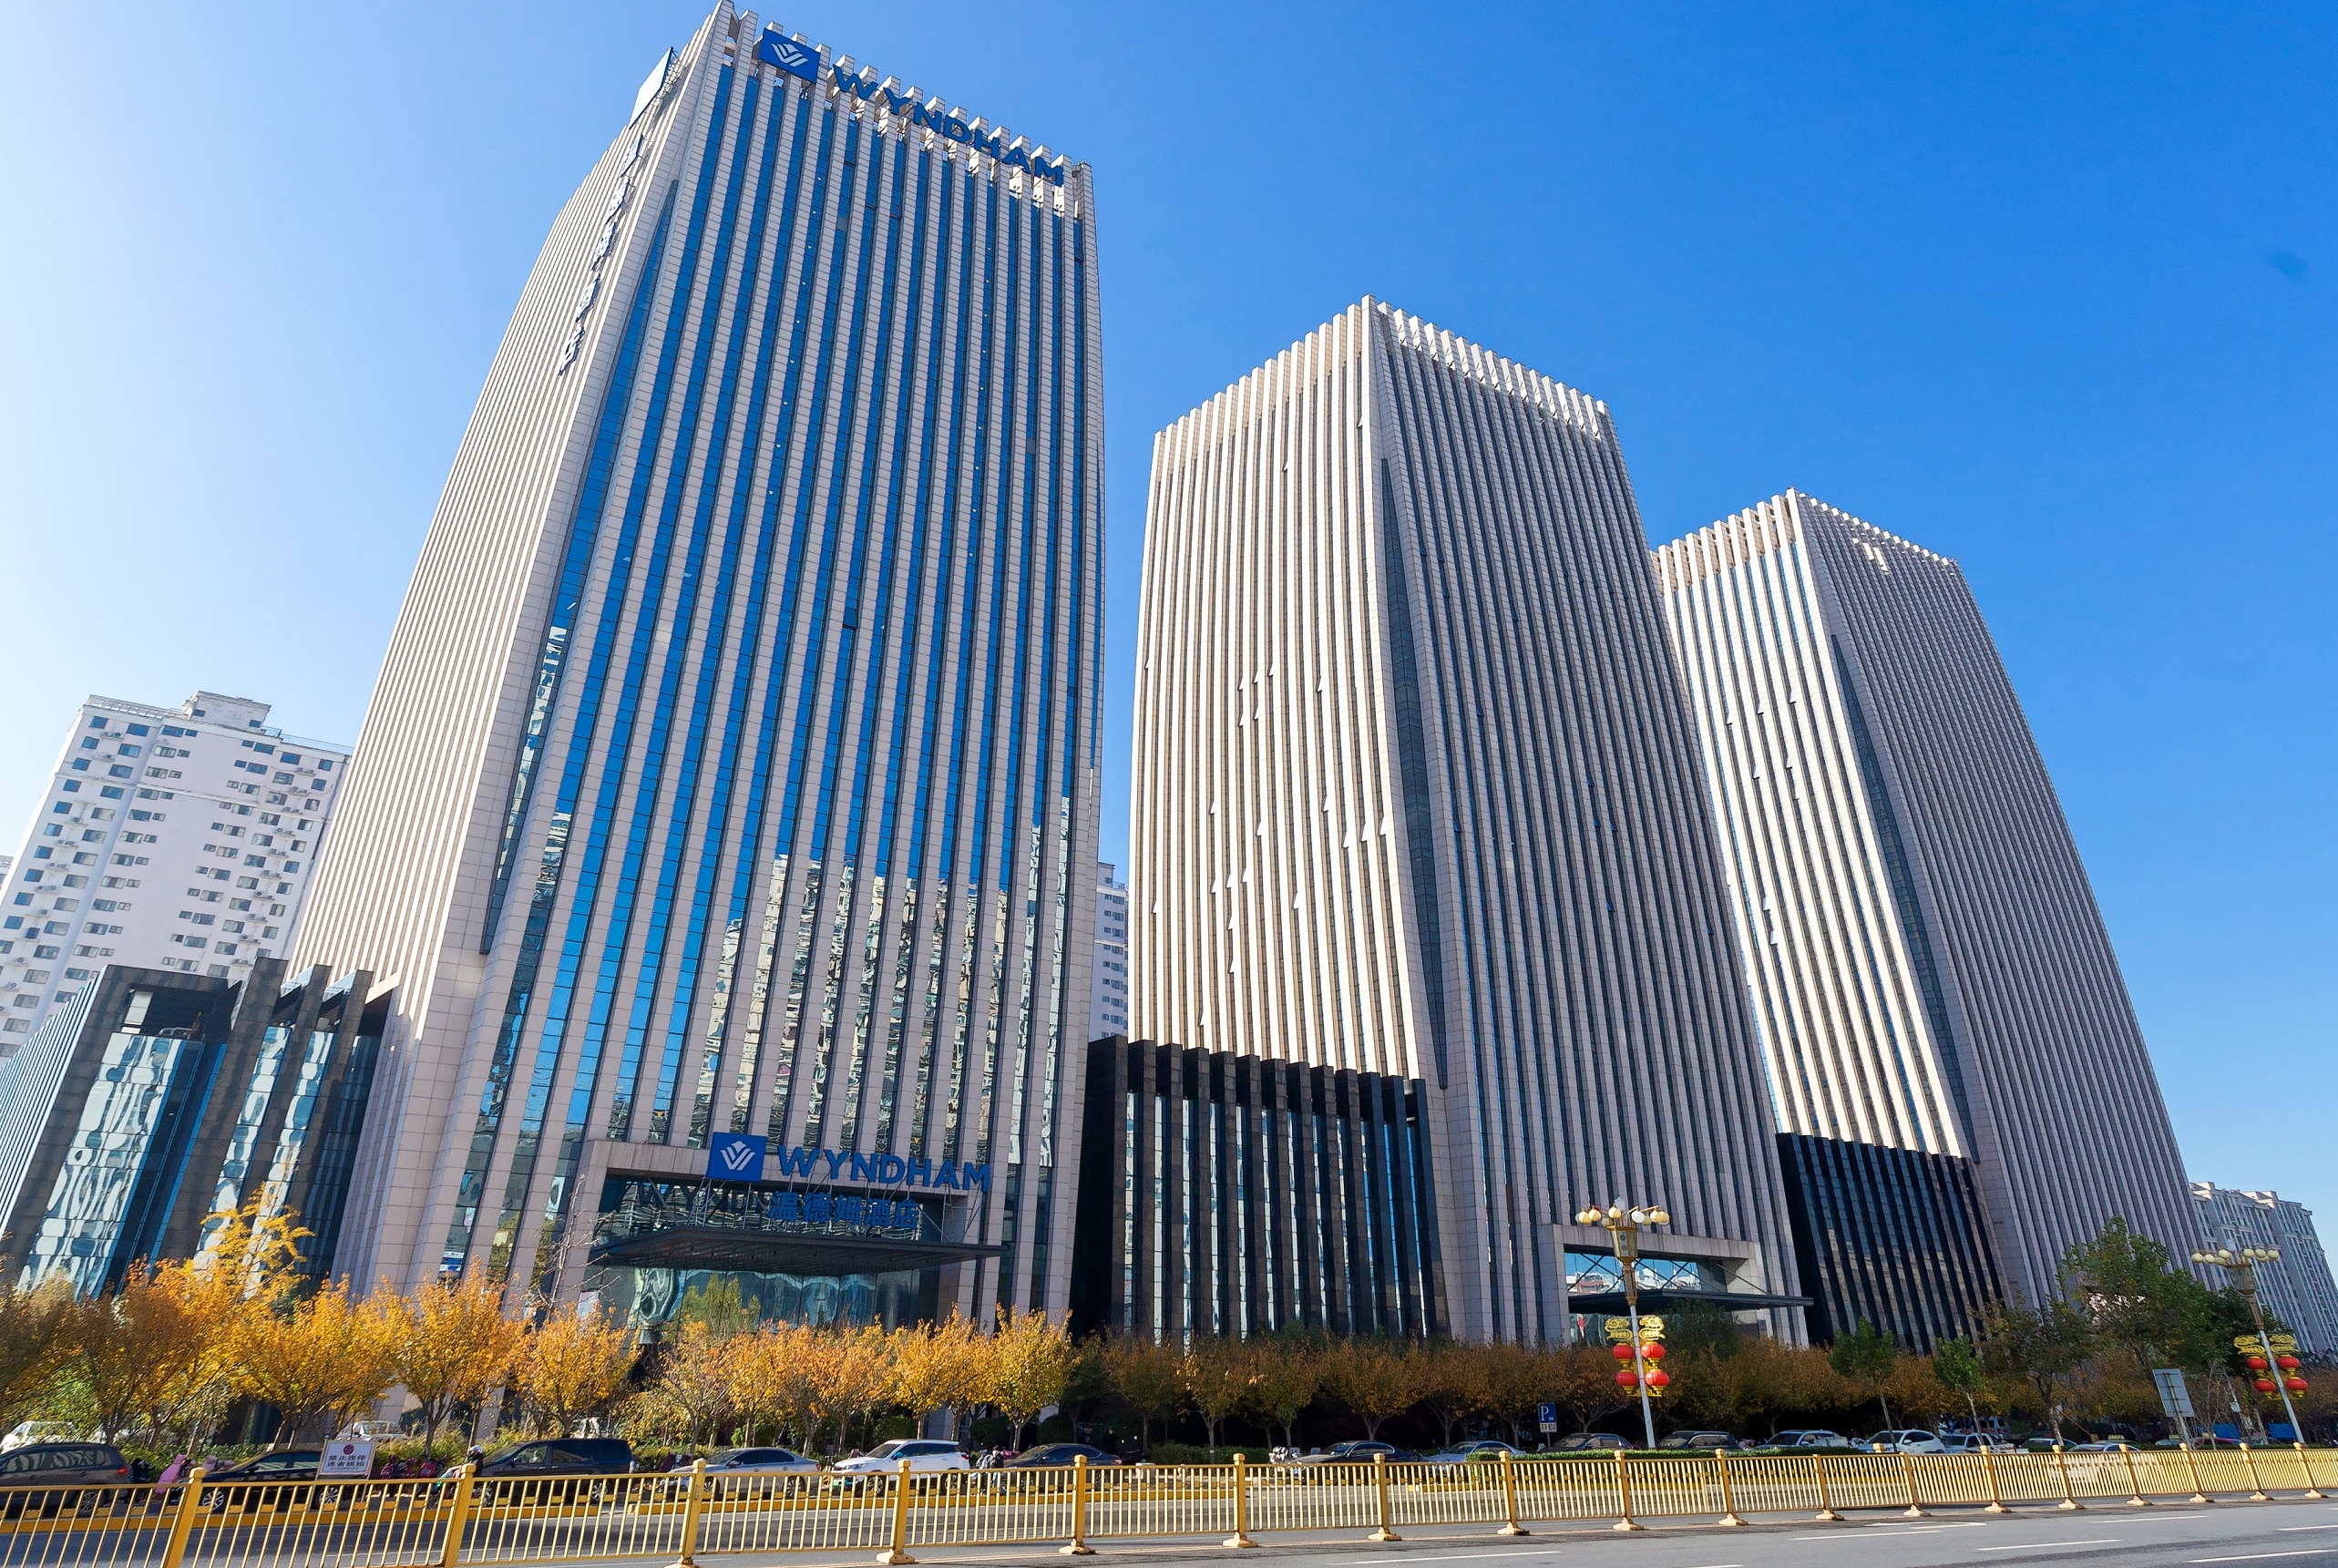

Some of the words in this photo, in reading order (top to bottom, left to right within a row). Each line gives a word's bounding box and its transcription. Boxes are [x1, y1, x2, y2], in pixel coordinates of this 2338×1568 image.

[833, 64, 1064, 188] WYNDHAM
[778, 1145, 990, 1192] WYNDHAM
[768, 1191, 919, 1230] 温德姆酒店
[1541, 1406, 1549, 1421] P
